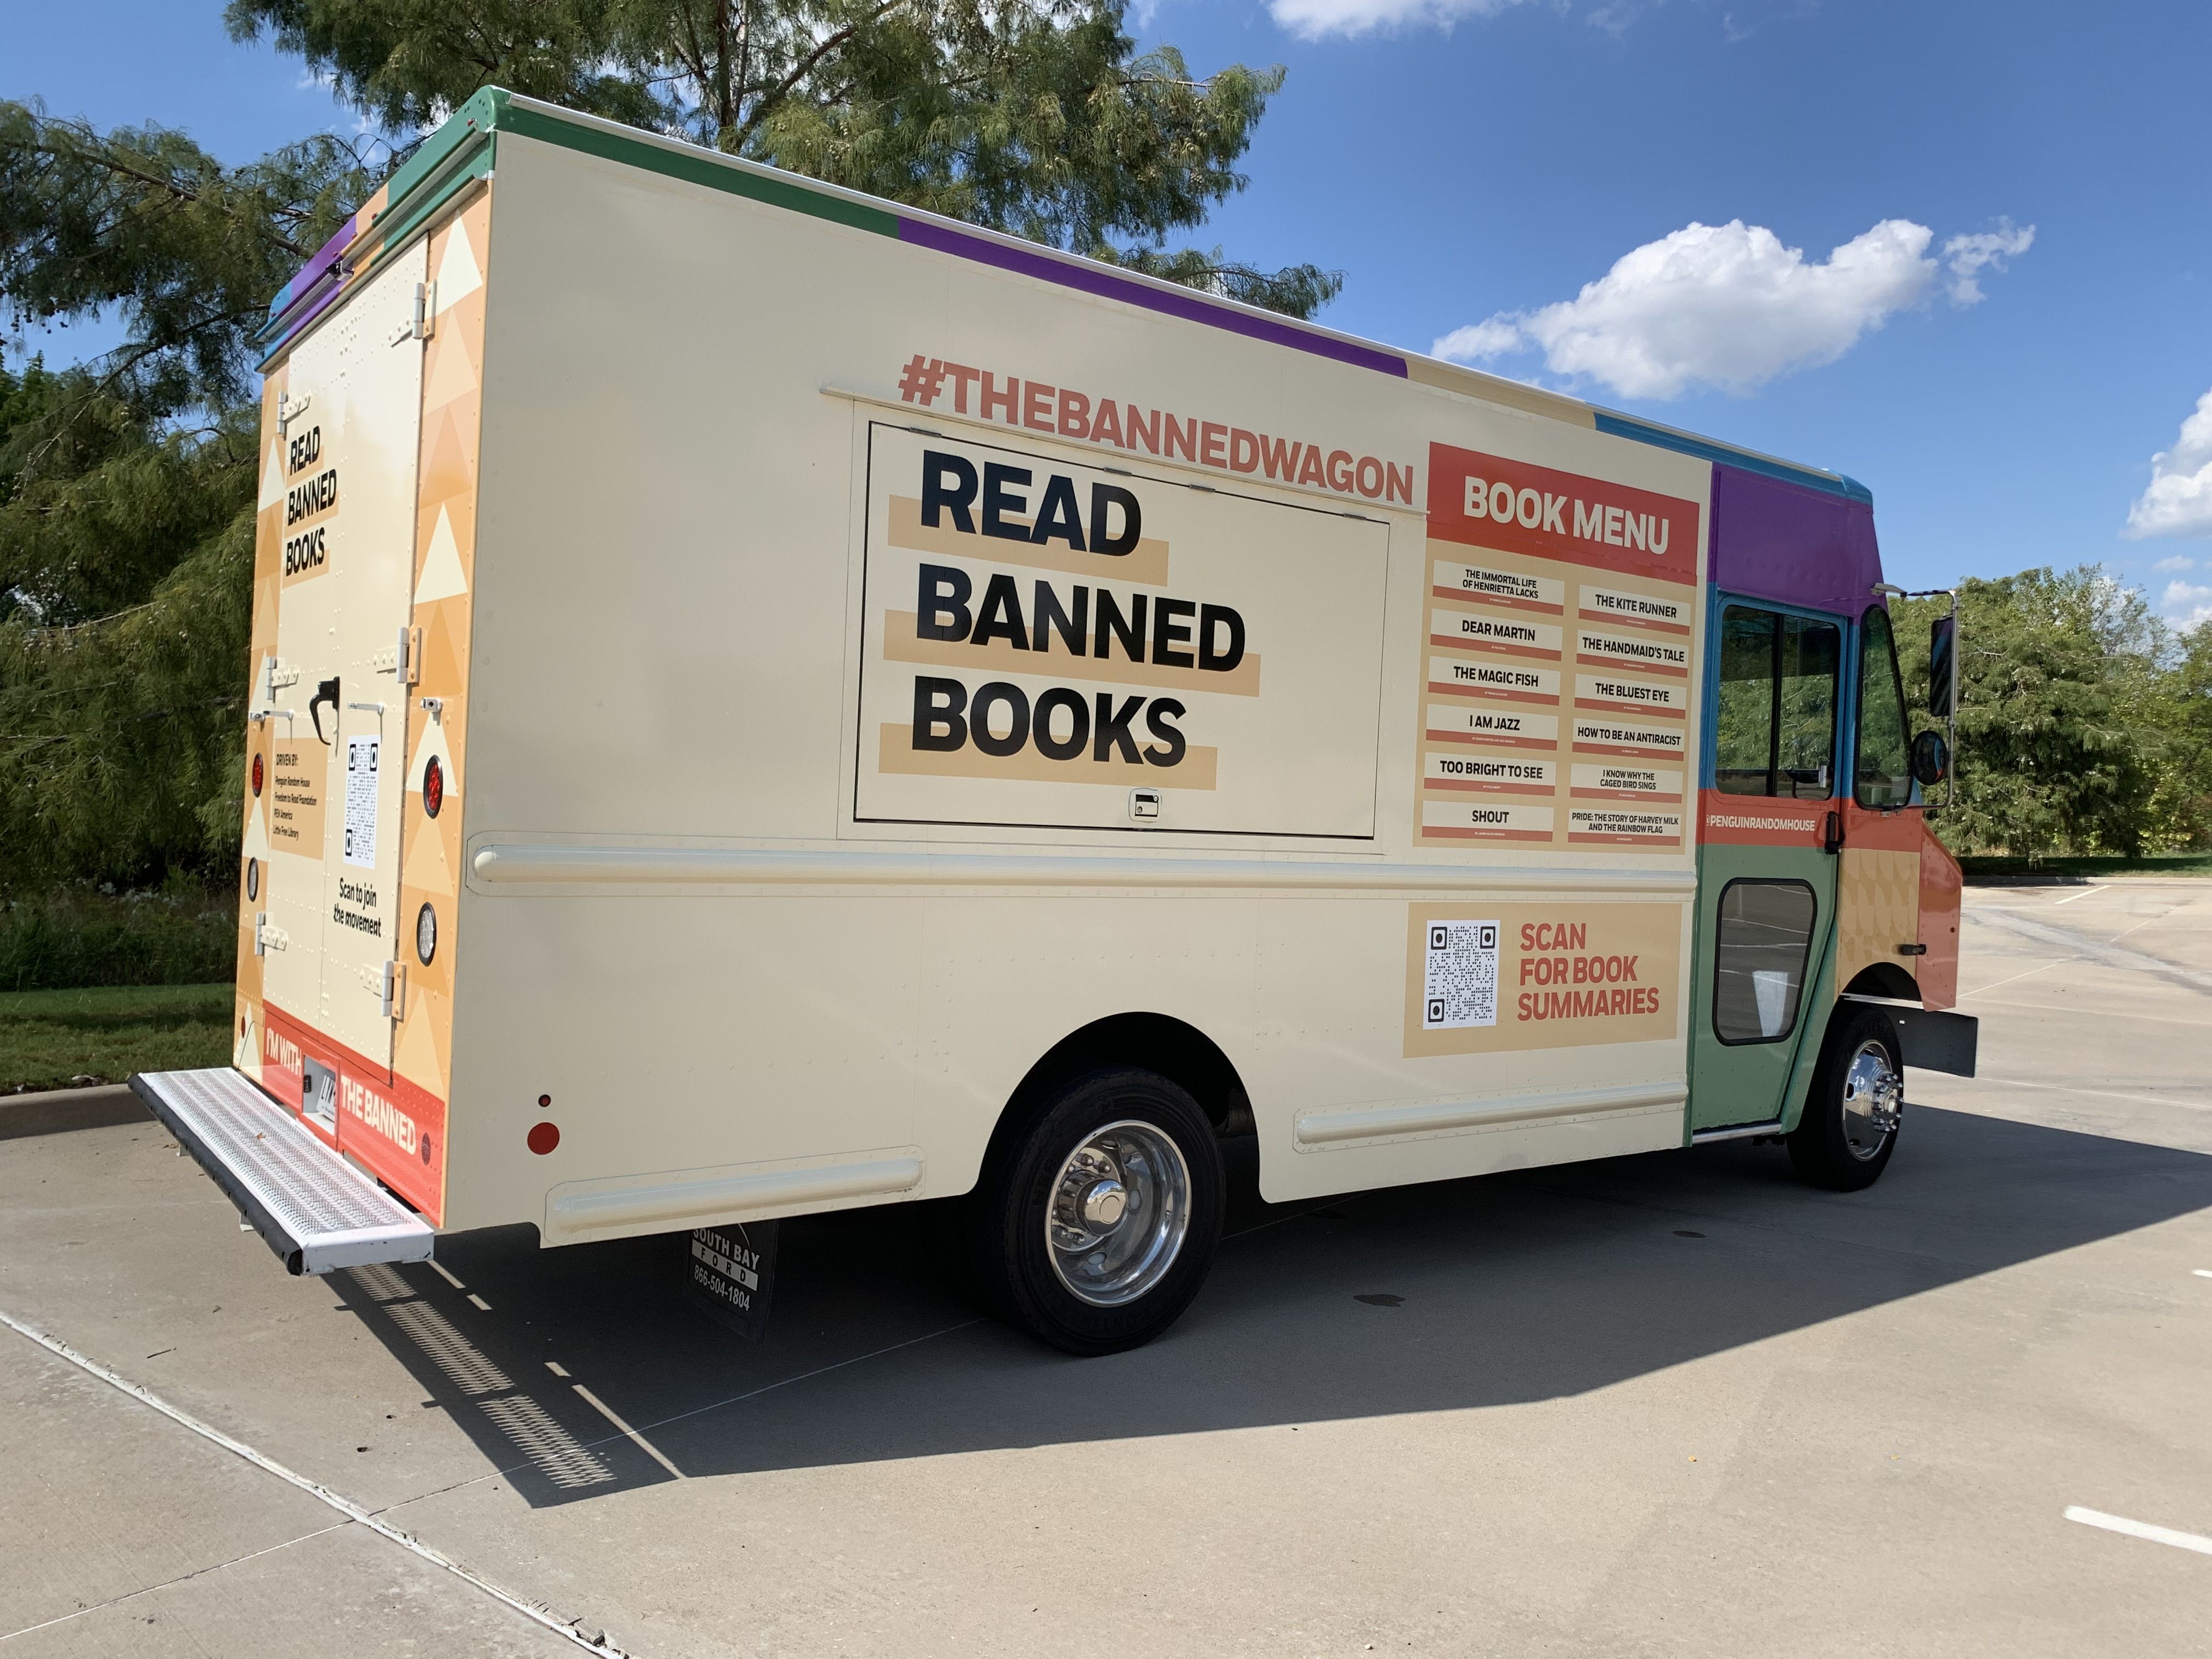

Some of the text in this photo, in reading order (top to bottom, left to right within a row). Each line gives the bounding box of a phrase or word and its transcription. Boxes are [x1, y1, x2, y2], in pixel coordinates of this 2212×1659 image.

[898, 354, 1413, 504] #THEBANNEDWAGON
[290, 425, 320, 476] READ
[288, 469, 337, 527] BANNED
[921, 449, 1142, 557] READ
[1464, 475, 1669, 555] BOOK MENU
[286, 527, 325, 577] BOOKS
[1463, 579, 1538, 599] OF HENRIETTA LACKS
[1465, 569, 1537, 588] THE IMMORTAL LIFE
[916, 562, 1245, 672] BANNED
[1595, 594, 1677, 618] THE KITE RUNNER
[1462, 619, 1535, 641] DEAR MARTIN
[1583, 637, 1684, 662] THE HANDMAID'S TALE
[1454, 665, 1538, 687] THE MAGIC FISH
[1595, 682, 1669, 702] THE BLUEST EYE
[912, 675, 1187, 768] BOOKS
[1470, 715, 1520, 731] I AM JAZZ
[1578, 727, 1681, 746] HOW TO BE AN ANTIRACIST
[276, 753, 291, 766] DRIVEN
[1440, 760, 1543, 779] TOO BRIGHT TO SEE
[275, 775, 310, 788] Penguin Random House
[1600, 779, 1656, 790] CAGED BIRD SINGS
[1606, 770, 1627, 778] KNOW
[1627, 771, 1641, 780] WHY
[1642, 772, 1655, 781] THE
[275, 792, 287, 803] Freedom
[287, 794, 291, 803] to
[299, 794, 317, 806] Foundation
[280, 809, 293, 820] America
[1472, 810, 1509, 823] SHOUT
[1572, 812, 1678, 825] PRIDE: THE STORY OF HARVEY MILK
[288, 827, 299, 841] Library
[1588, 823, 1602, 831] AND
[1604, 823, 1616, 832] THE
[1617, 825, 1646, 833] RAINBOW
[340, 877, 376, 911] Scan to join
[334, 902, 381, 938] the movement
[1520, 923, 1587, 951] SCAN
[1520, 955, 1639, 986] FOR BOOK
[1517, 987, 1659, 1022] SUMMARIES
[267, 1027, 302, 1078] I'M WITH
[341, 1074, 364, 1120] THE
[364, 1088, 416, 1155] BANNED
[693, 1228, 760, 1271] SOUTH BAY
[701, 1247, 746, 1282] FORD
[694, 1264, 750, 1311] 866-504-1804
